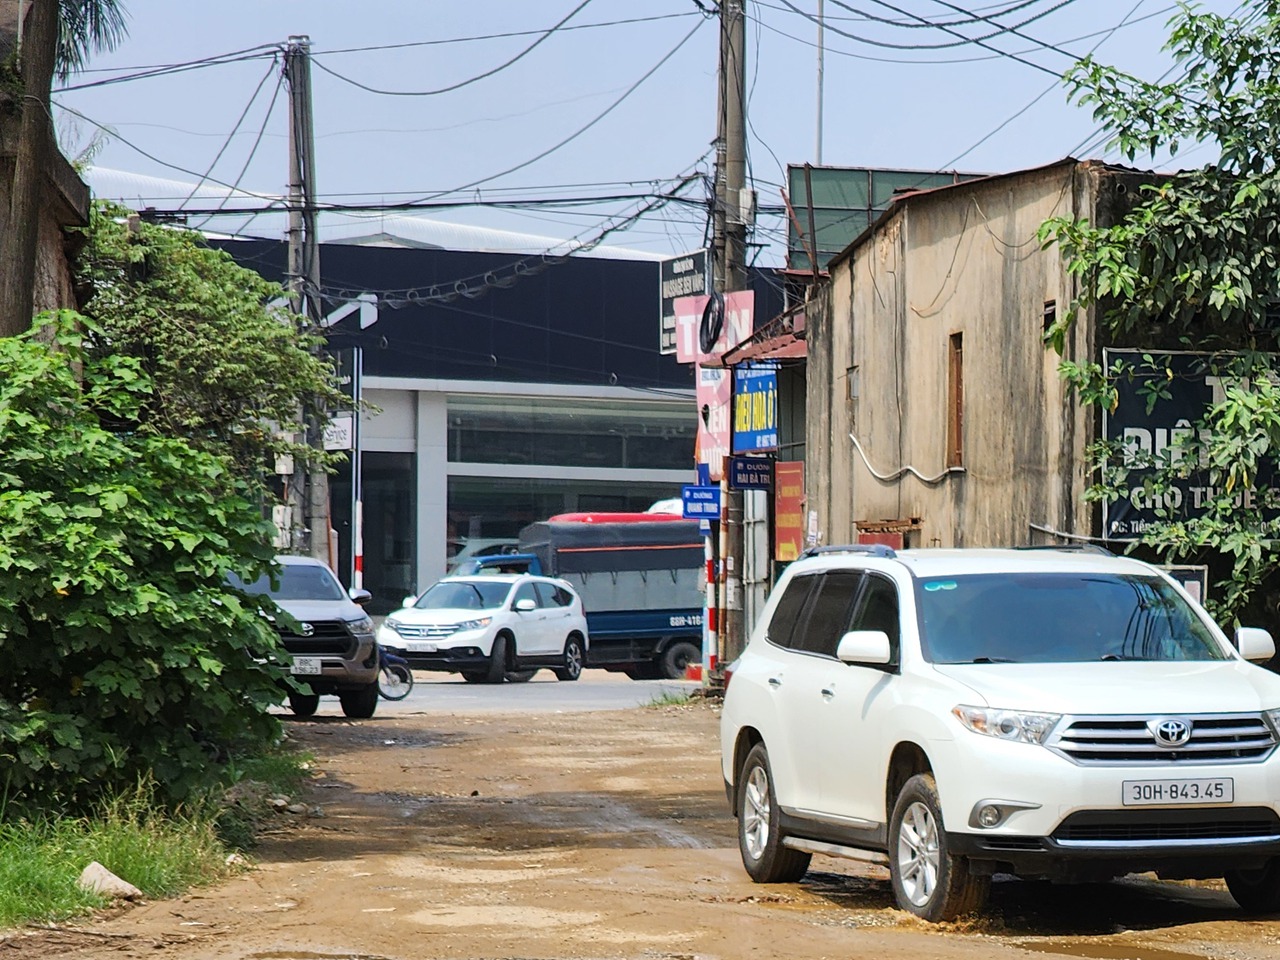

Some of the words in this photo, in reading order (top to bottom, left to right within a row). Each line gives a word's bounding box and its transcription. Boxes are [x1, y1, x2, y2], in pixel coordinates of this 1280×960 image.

[737, 474, 748, 483] HAI
[750, 472, 759, 484] BÀ
[1132, 782, 1224, 801] 30H-843.45
